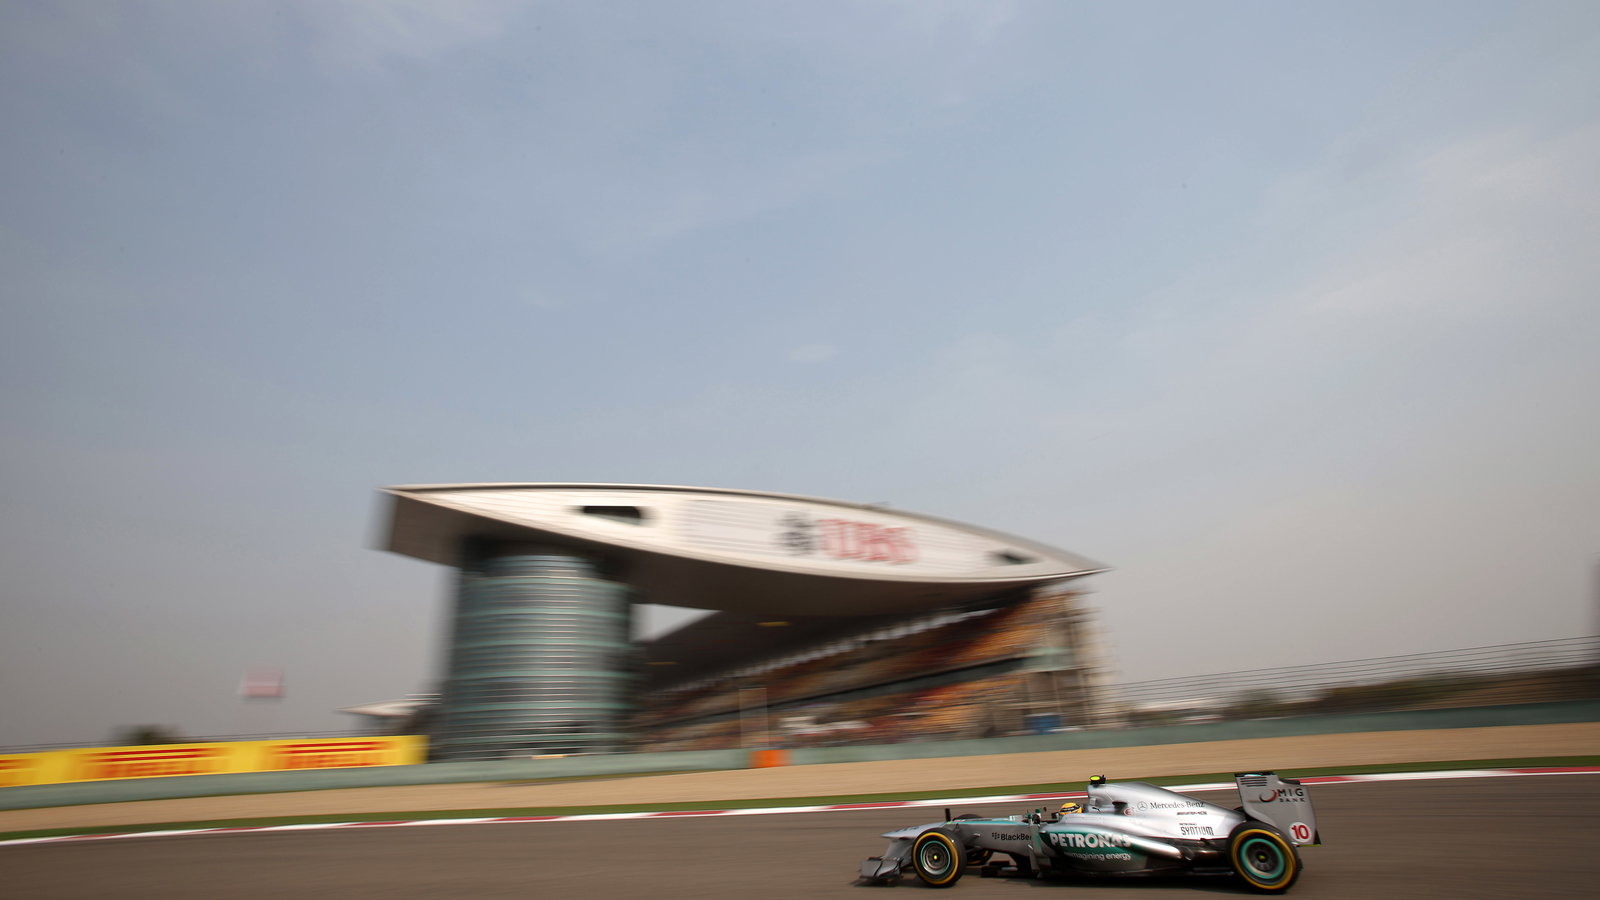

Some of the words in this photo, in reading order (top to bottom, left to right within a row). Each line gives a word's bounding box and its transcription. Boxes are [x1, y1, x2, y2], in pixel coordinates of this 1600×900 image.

[1277, 788, 1304, 797] MIG
[1291, 825, 1309, 839] 10
[1049, 833, 1132, 848] PETRONAS
[1105, 853, 1132, 861] energy
